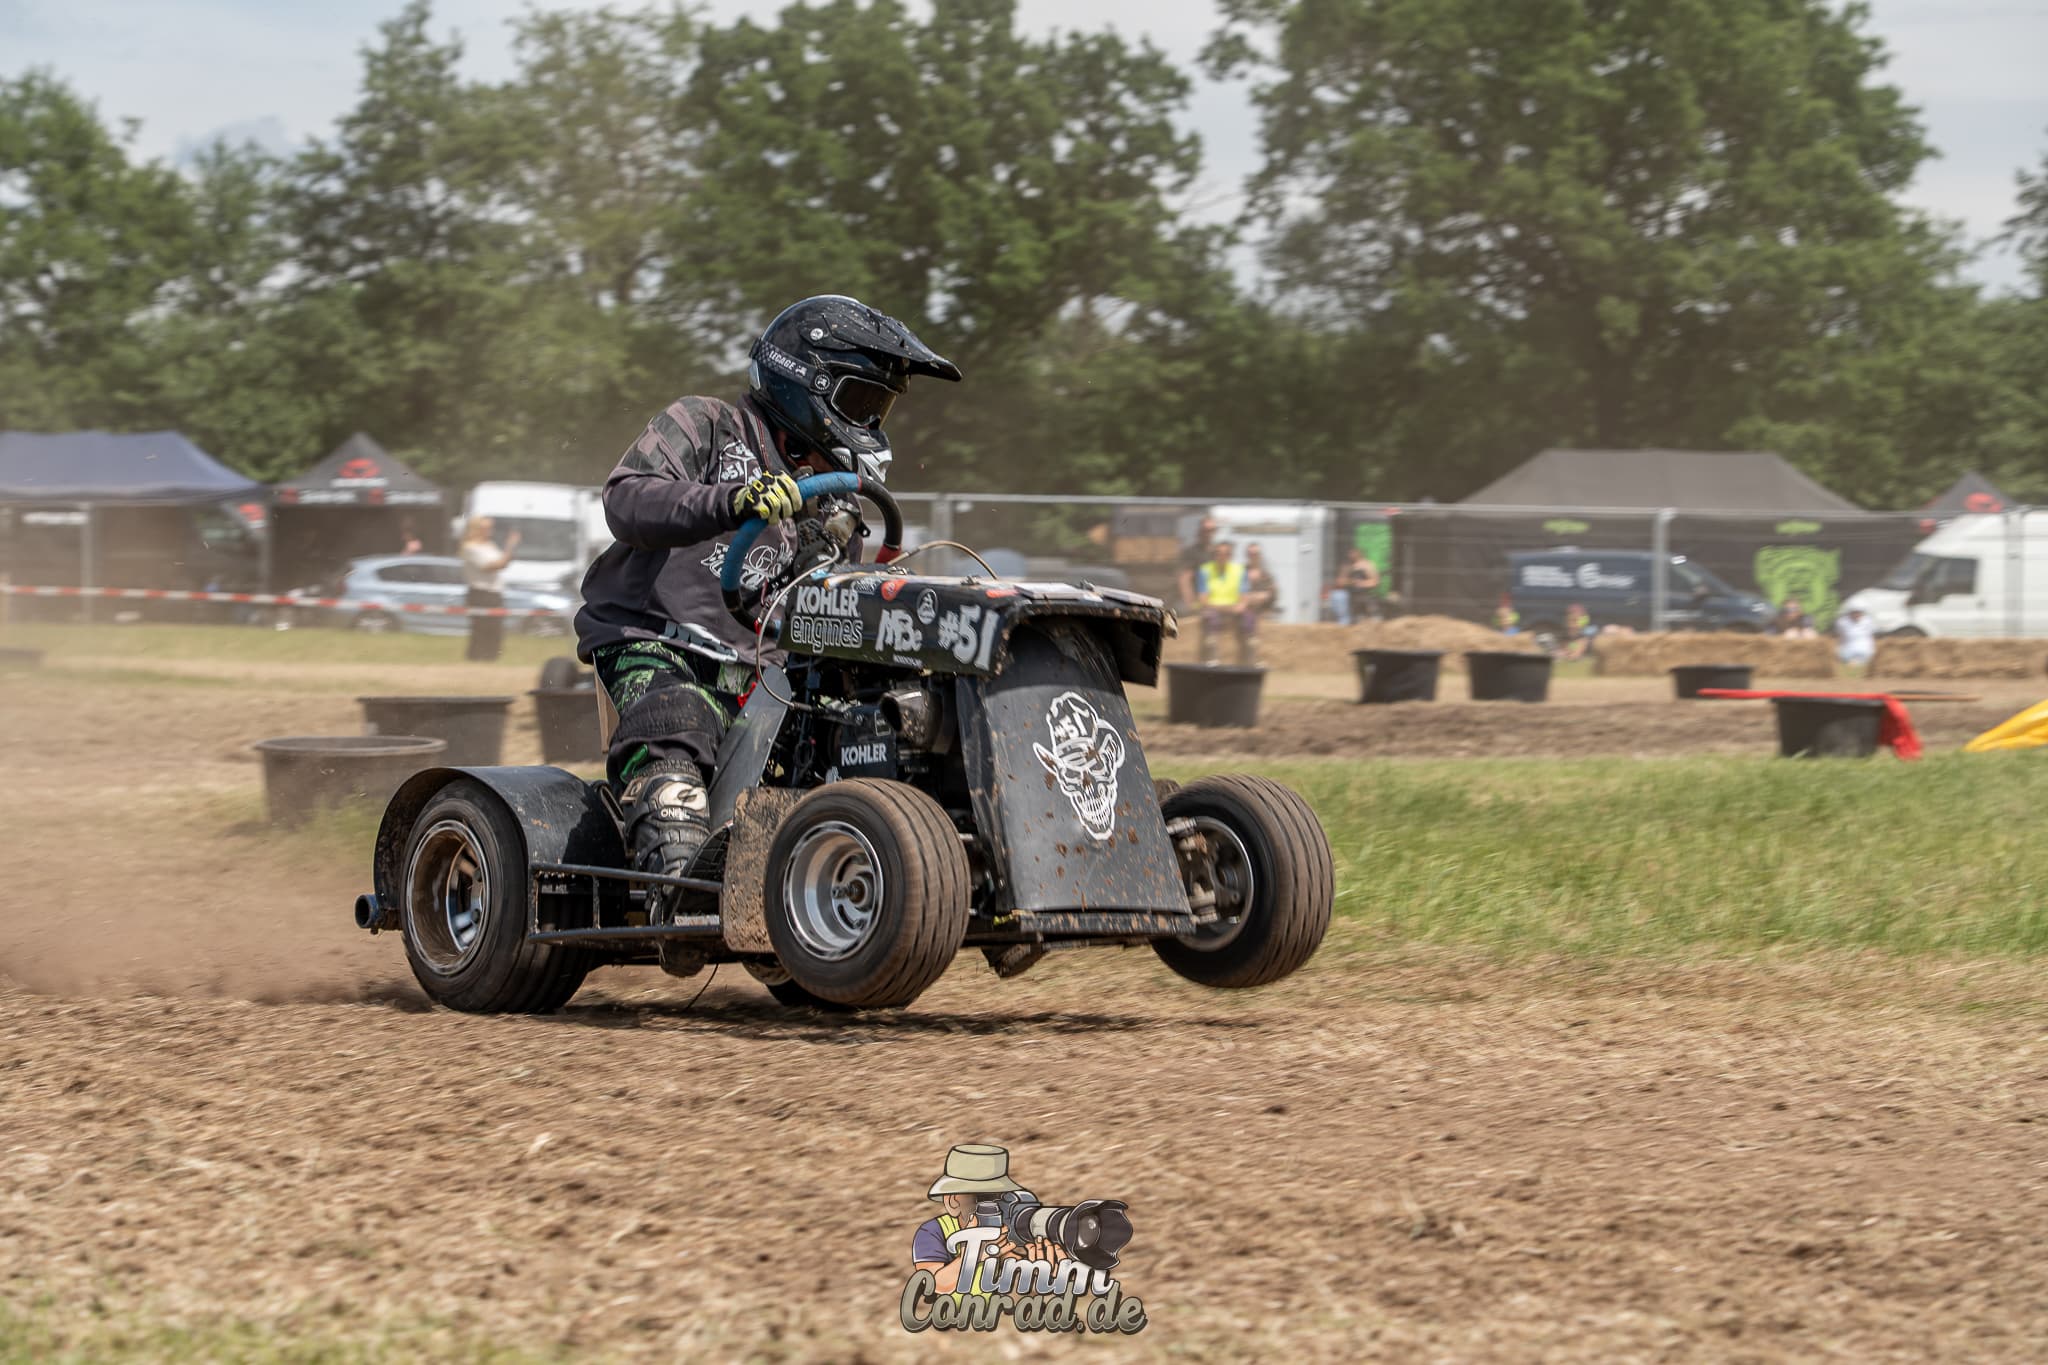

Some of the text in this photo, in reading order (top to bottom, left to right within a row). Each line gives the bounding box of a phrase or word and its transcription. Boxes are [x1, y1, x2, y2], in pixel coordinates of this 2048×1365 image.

[796, 585, 861, 618] KOHLER
[791, 615, 863, 654] engines
[938, 604, 999, 671] #51
[841, 743, 887, 767] KOHLER
